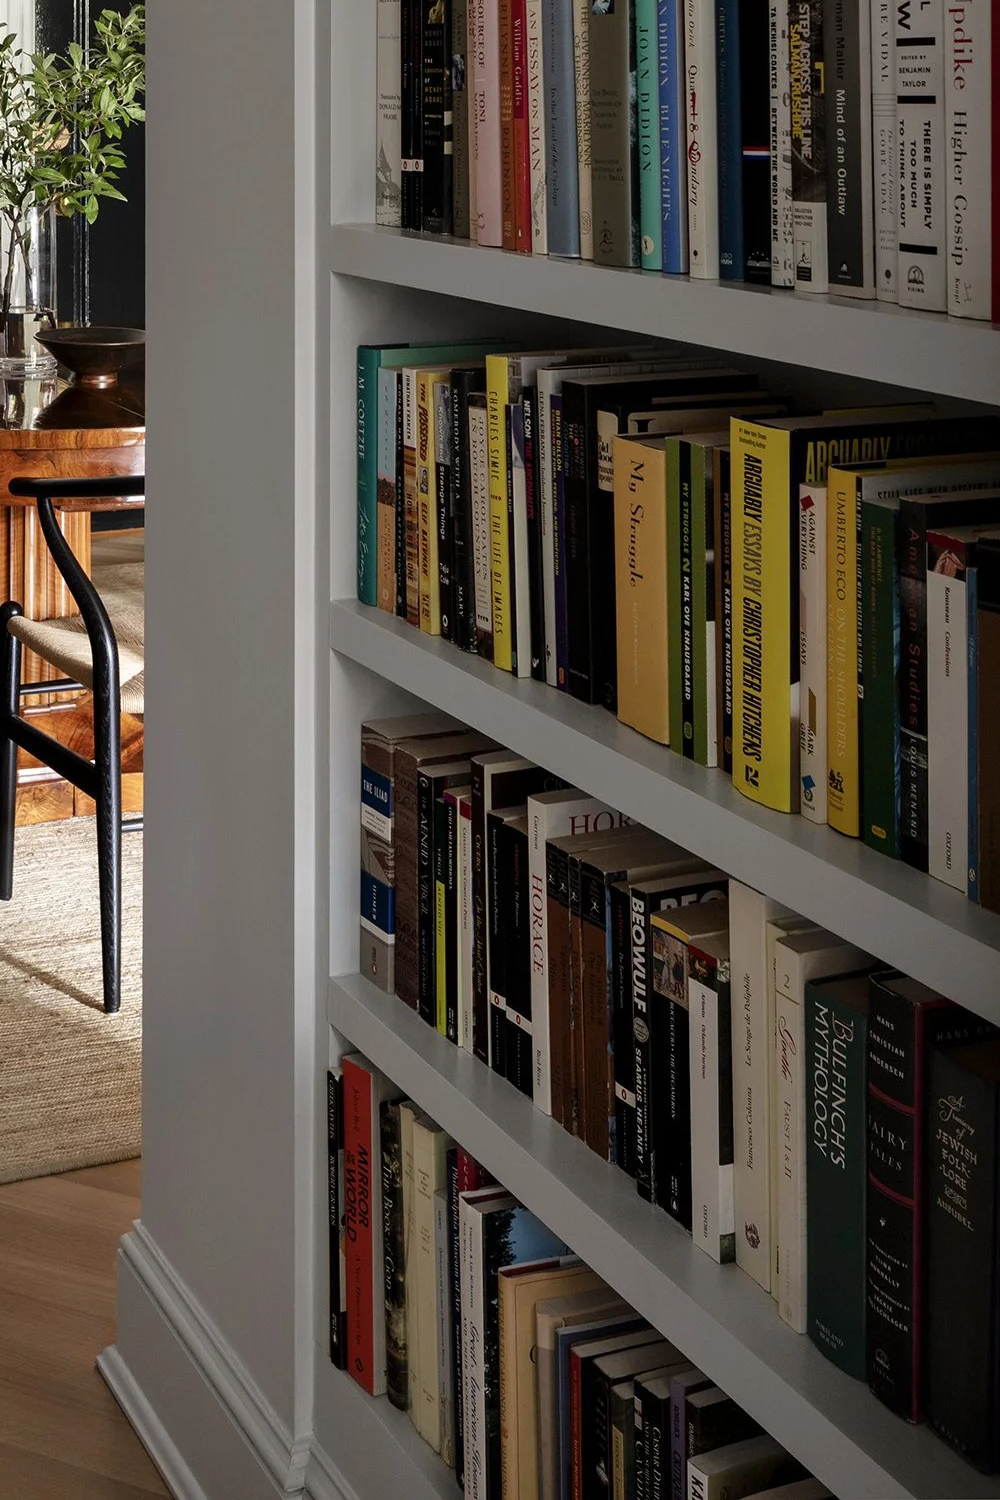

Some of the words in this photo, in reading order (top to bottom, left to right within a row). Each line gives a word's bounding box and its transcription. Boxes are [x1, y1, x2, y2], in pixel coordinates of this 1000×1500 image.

[639, 27, 650, 80] JOAN
[640, 93, 652, 173] DIDION
[923, 120, 932, 163] THERE
[951, 111, 968, 185] Higher
[923, 167, 932, 179] IS
[924, 183, 932, 230] SIMPLY
[951, 195, 968, 266] Gossip
[419, 382, 427, 403] THE
[418, 404, 429, 462] POSSESSED
[489, 391, 499, 441] CHARLES
[490, 449, 500, 481] SIMIC
[627, 460, 645, 493] My
[742, 453, 762, 523] ARGUABLY
[420, 501, 429, 524] ELIF
[682, 482, 691, 499] MY
[491, 515, 501, 534] THE
[627, 503, 644, 588] Struggle
[682, 501, 691, 554] STRUGGLE
[742, 522, 762, 573] ESSAYS
[799, 508, 808, 570] EVERYTHING
[808, 510, 816, 555] AGAINST
[836, 490, 847, 565] UMBERTO
[421, 530, 429, 577] BATUMAN
[493, 542, 502, 565] LIFE
[682, 558, 691, 572] 2
[494, 571, 502, 585] OF
[683, 576, 692, 603] KARL
[742, 575, 762, 597] BY
[836, 570, 847, 600] ECO
[494, 590, 503, 634] IMAGES
[683, 606, 692, 626] OVE
[944, 586, 952, 623] Rousseau
[683, 630, 692, 701] KNAUSGAARD
[742, 597, 762, 691] CHRISTOPHER
[944, 631, 952, 677] Confessions
[742, 691, 762, 762] HITCHENS
[806, 727, 815, 756] MARK
[909, 738, 918, 778] LOUIS
[909, 783, 918, 838] MENAND
[419, 813, 428, 866] AENEID
[419, 873, 428, 916] VIRGIL
[532, 873, 544, 976] HORACE
[632, 896, 647, 1013] BEOWULF
[869, 1029, 905, 1058] CHRISTIAN
[876, 1015, 895, 1030] HANS
[635, 1047, 643, 1102] SEAMUS
[812, 1000, 829, 1159] MYTHOLOGY
[869, 1052, 904, 1079] ANDERSEN
[829, 1012, 854, 1170] BULFINCH'S
[635, 1108, 644, 1164] HEANEY
[936, 1129, 977, 1166] JEWISH
[346, 1167, 357, 1243] WORLD
[358, 1143, 369, 1229] MIRROR
[451, 1166, 459, 1231] Philadelphia
[936, 1197, 975, 1231] AUSUBEL
[453, 1281, 461, 1293] of
[469, 1321, 480, 1366] Great
[469, 1373, 481, 1442] American
[652, 1426, 661, 1467] CASPAR
[470, 1450, 481, 1499] Houses
